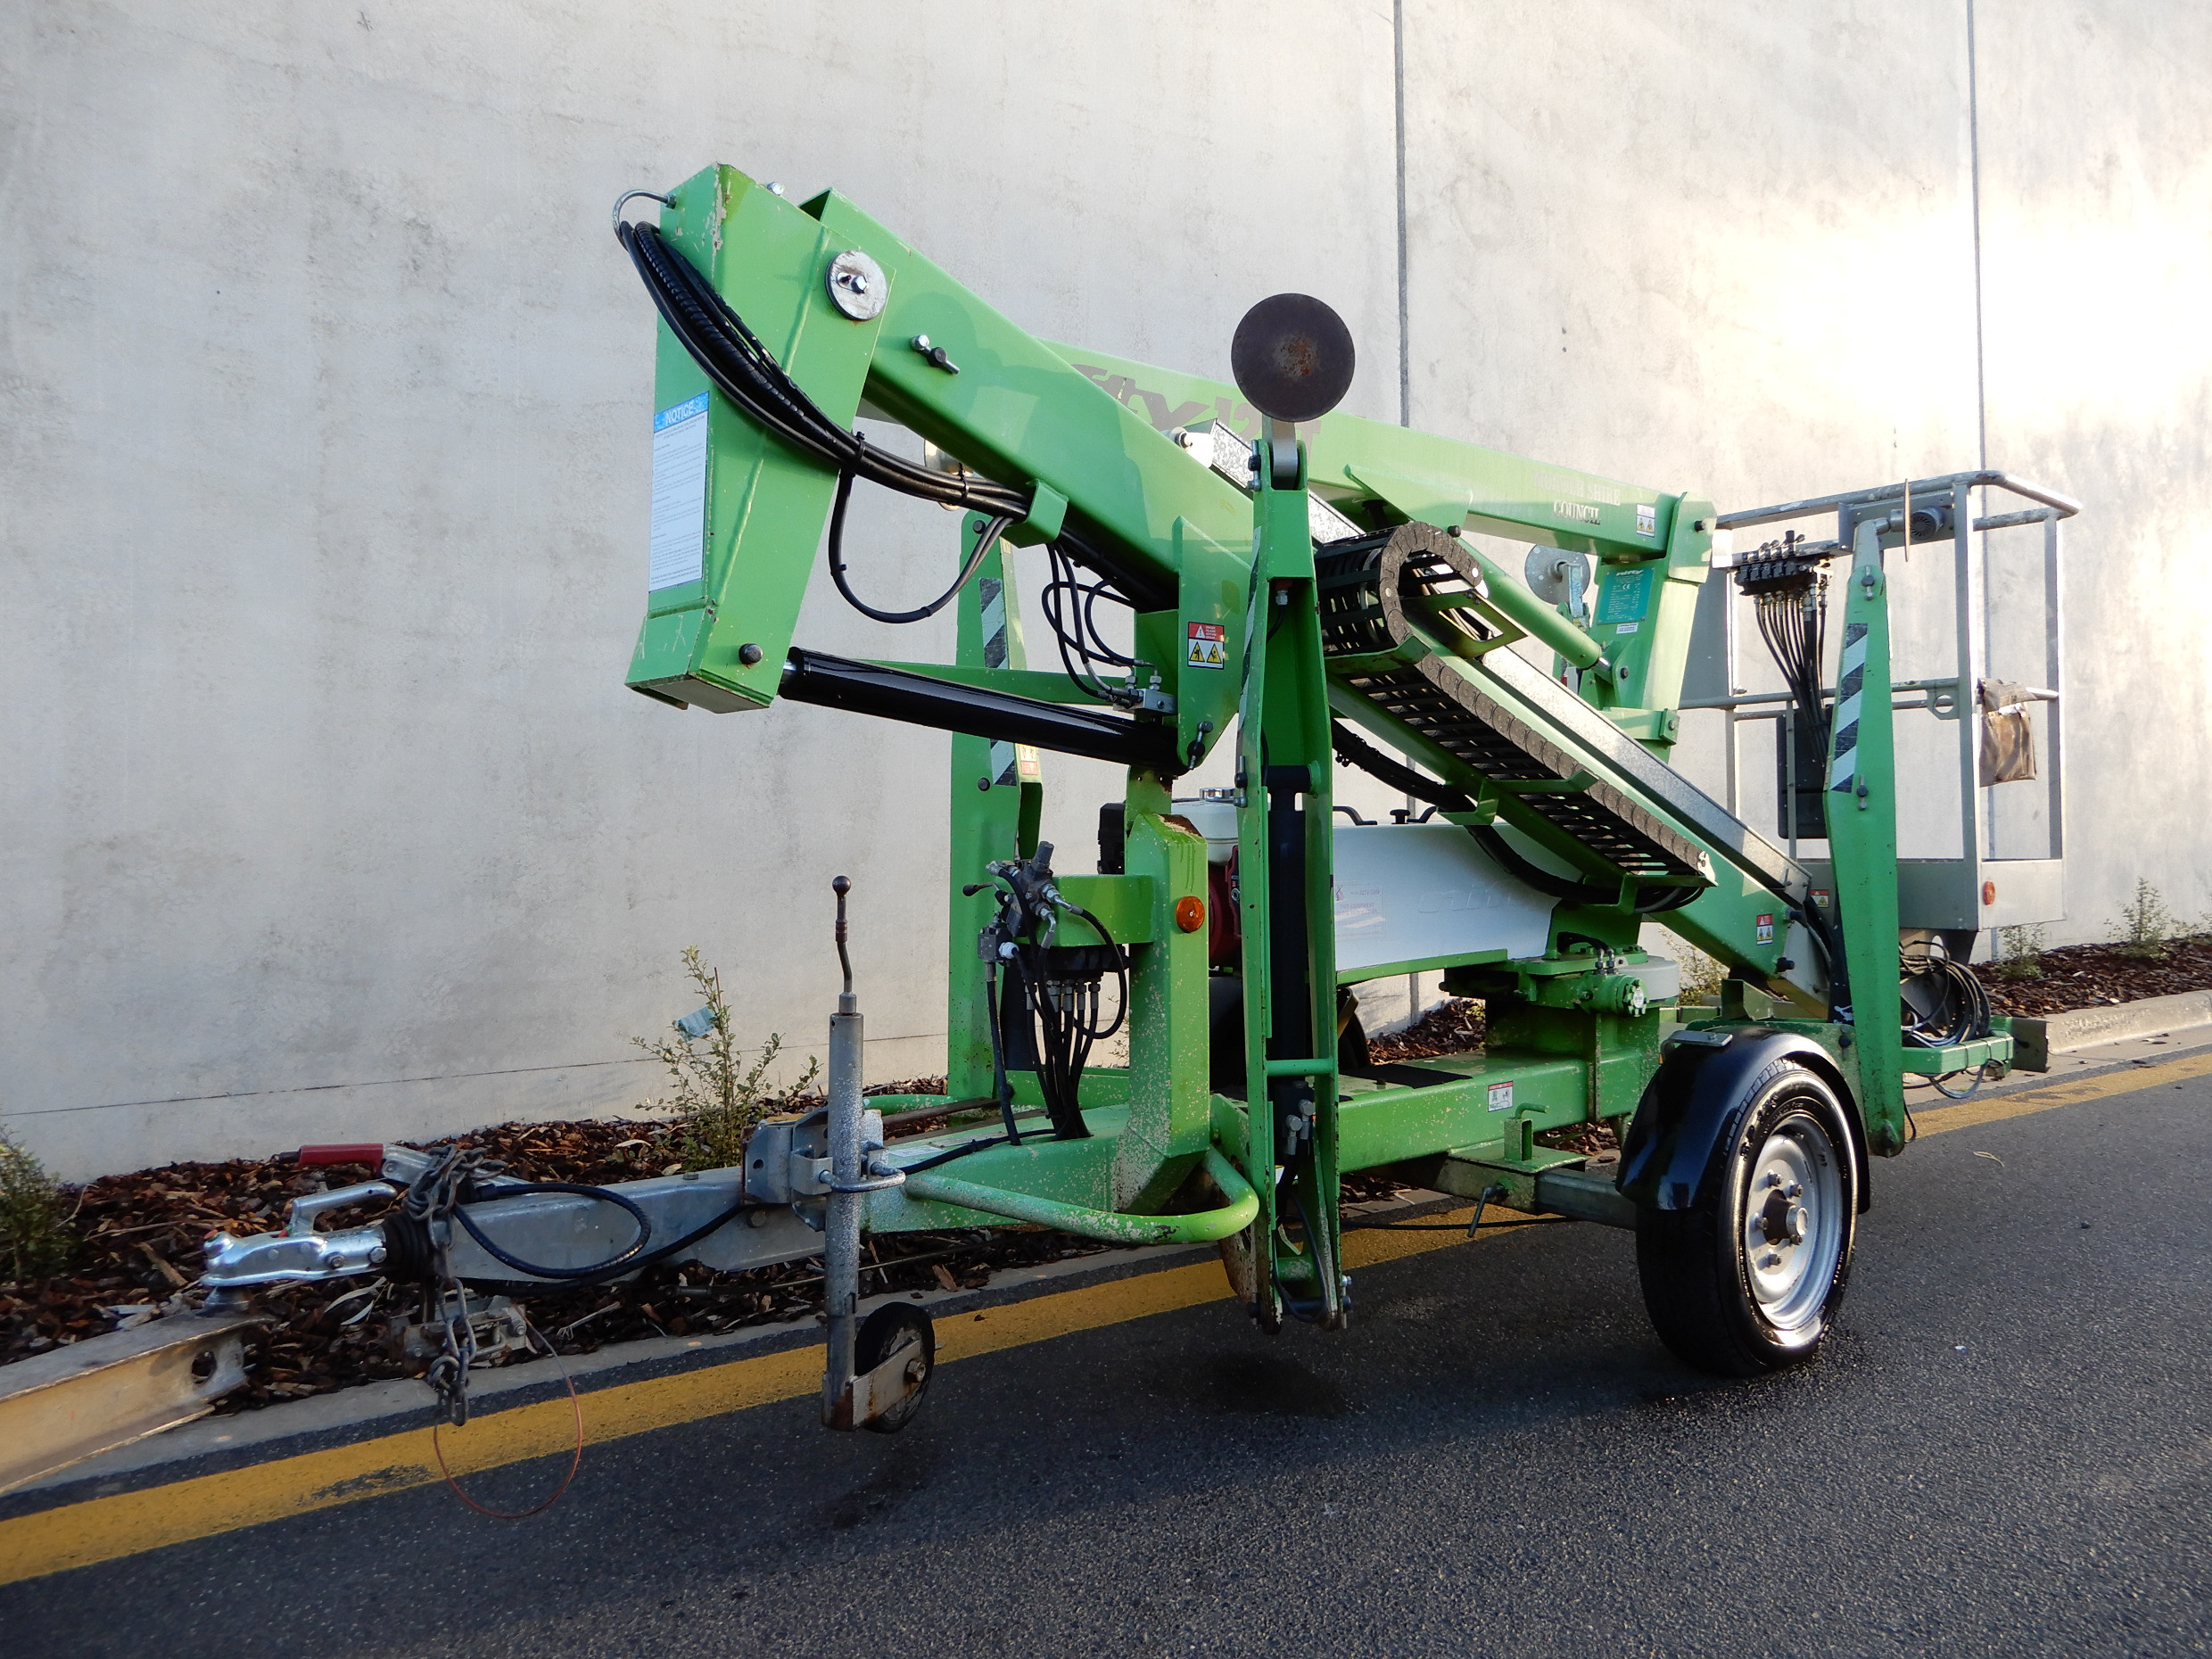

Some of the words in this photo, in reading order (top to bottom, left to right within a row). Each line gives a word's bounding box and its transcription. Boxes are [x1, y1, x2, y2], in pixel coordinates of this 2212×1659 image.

[665, 401, 694, 426] NOTICE
[1588, 483, 1621, 506] SHIRE
[1553, 499, 1602, 525] COUNCIL
